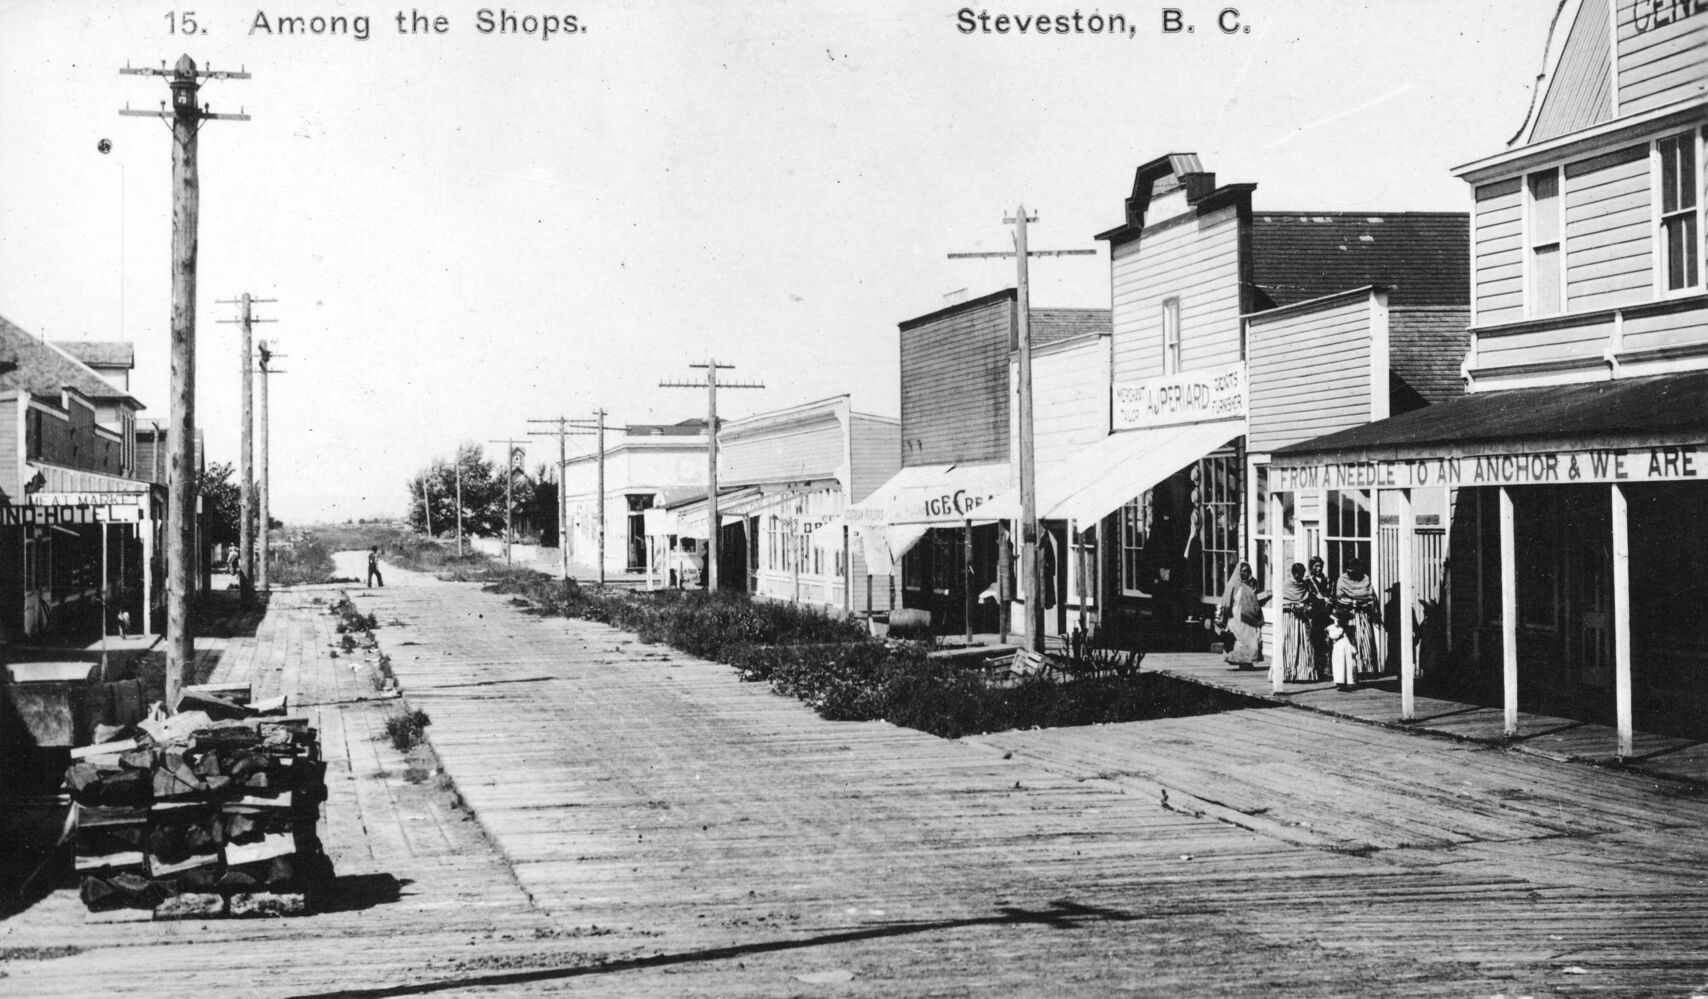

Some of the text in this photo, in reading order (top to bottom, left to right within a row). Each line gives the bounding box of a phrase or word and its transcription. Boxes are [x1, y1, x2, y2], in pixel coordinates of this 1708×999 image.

[1280, 446, 1697, 489] FROM A NEEDLE TO AN ANCHOR & WE ARE
[0, 503, 129, 525] ND-HOTEL.
